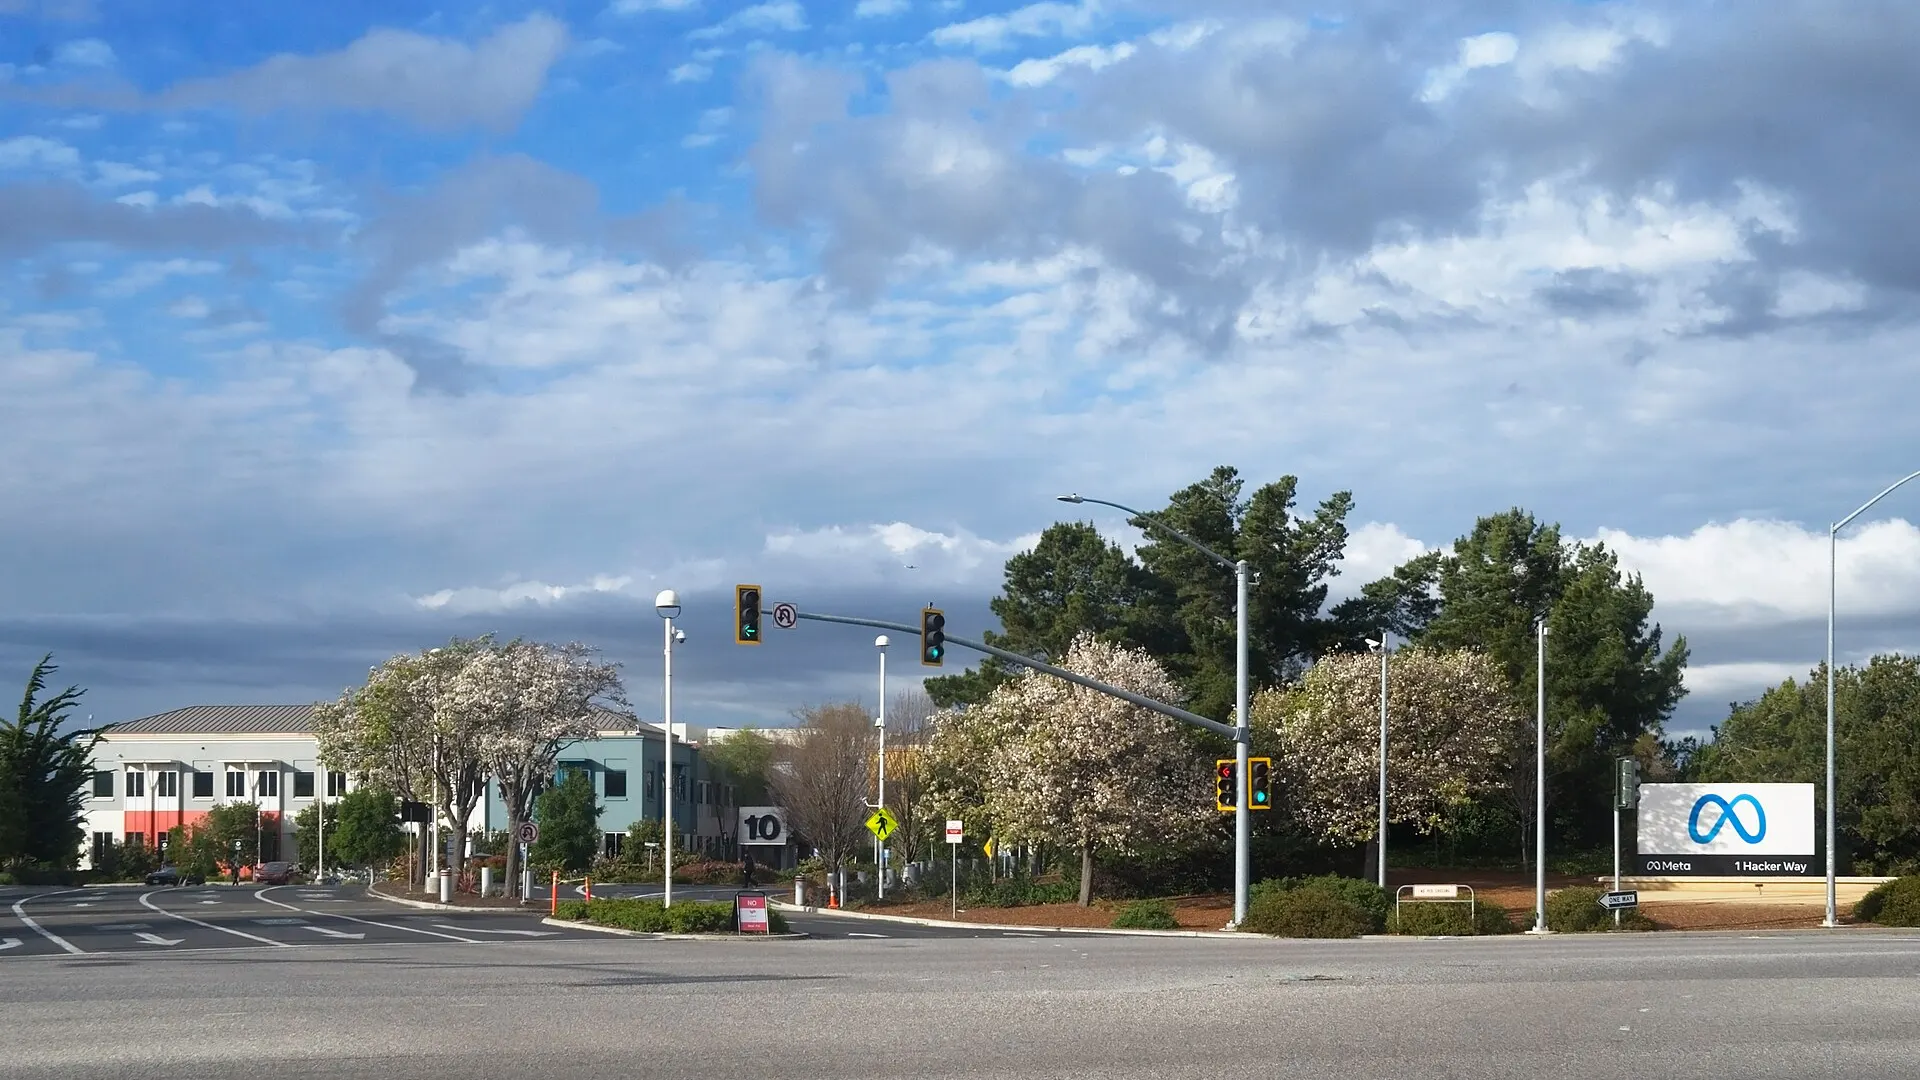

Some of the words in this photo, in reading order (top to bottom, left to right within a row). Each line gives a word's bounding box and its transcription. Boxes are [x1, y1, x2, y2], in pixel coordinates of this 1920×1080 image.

[744, 814, 781, 840] 10
[1662, 861, 1691, 871] Meta
[1734, 861, 1741, 871] 1
[1743, 861, 1781, 871] Hacker
[1783, 861, 1807, 873] Way
